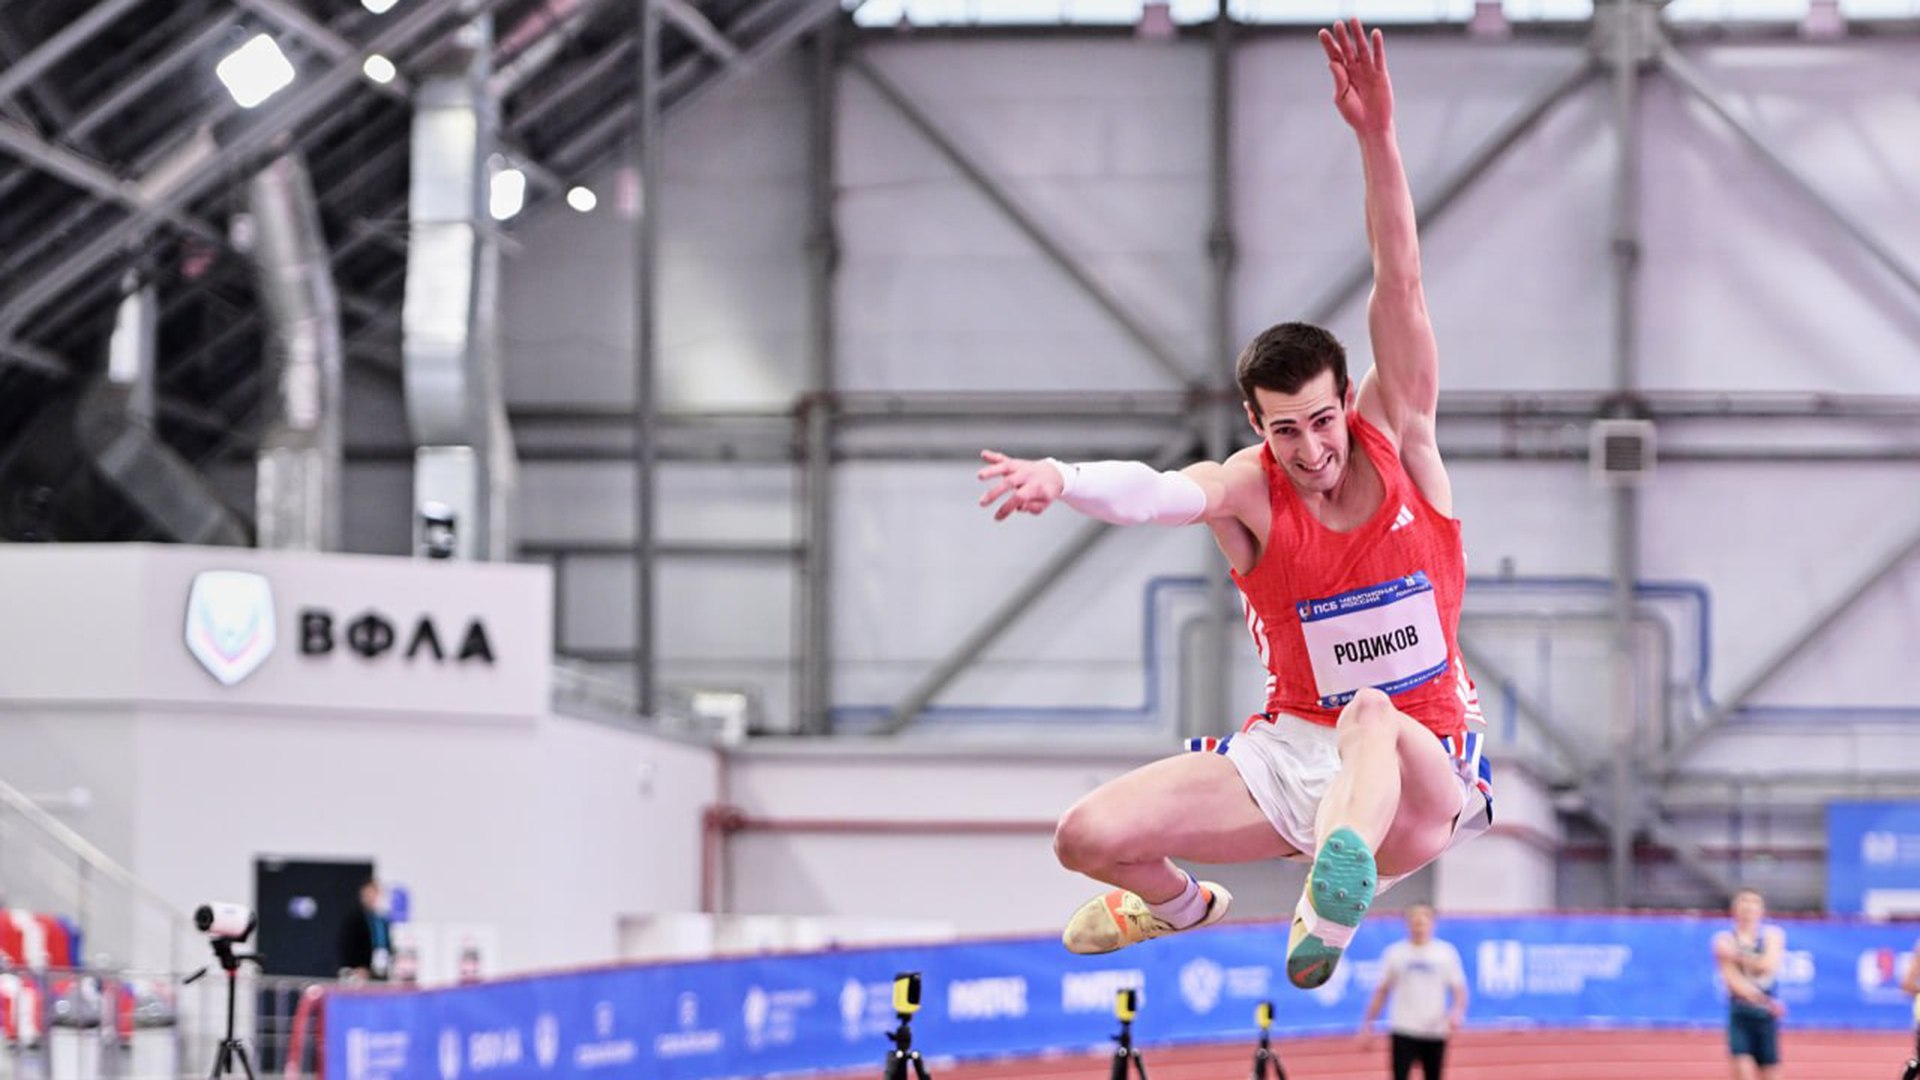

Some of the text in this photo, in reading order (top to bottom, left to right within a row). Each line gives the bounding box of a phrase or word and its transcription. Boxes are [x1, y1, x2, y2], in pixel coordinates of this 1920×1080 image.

[1313, 601, 1338, 615] ПСБ
[299, 607, 495, 663] ВФЛА
[1333, 625, 1419, 665] РОДИКОВ
